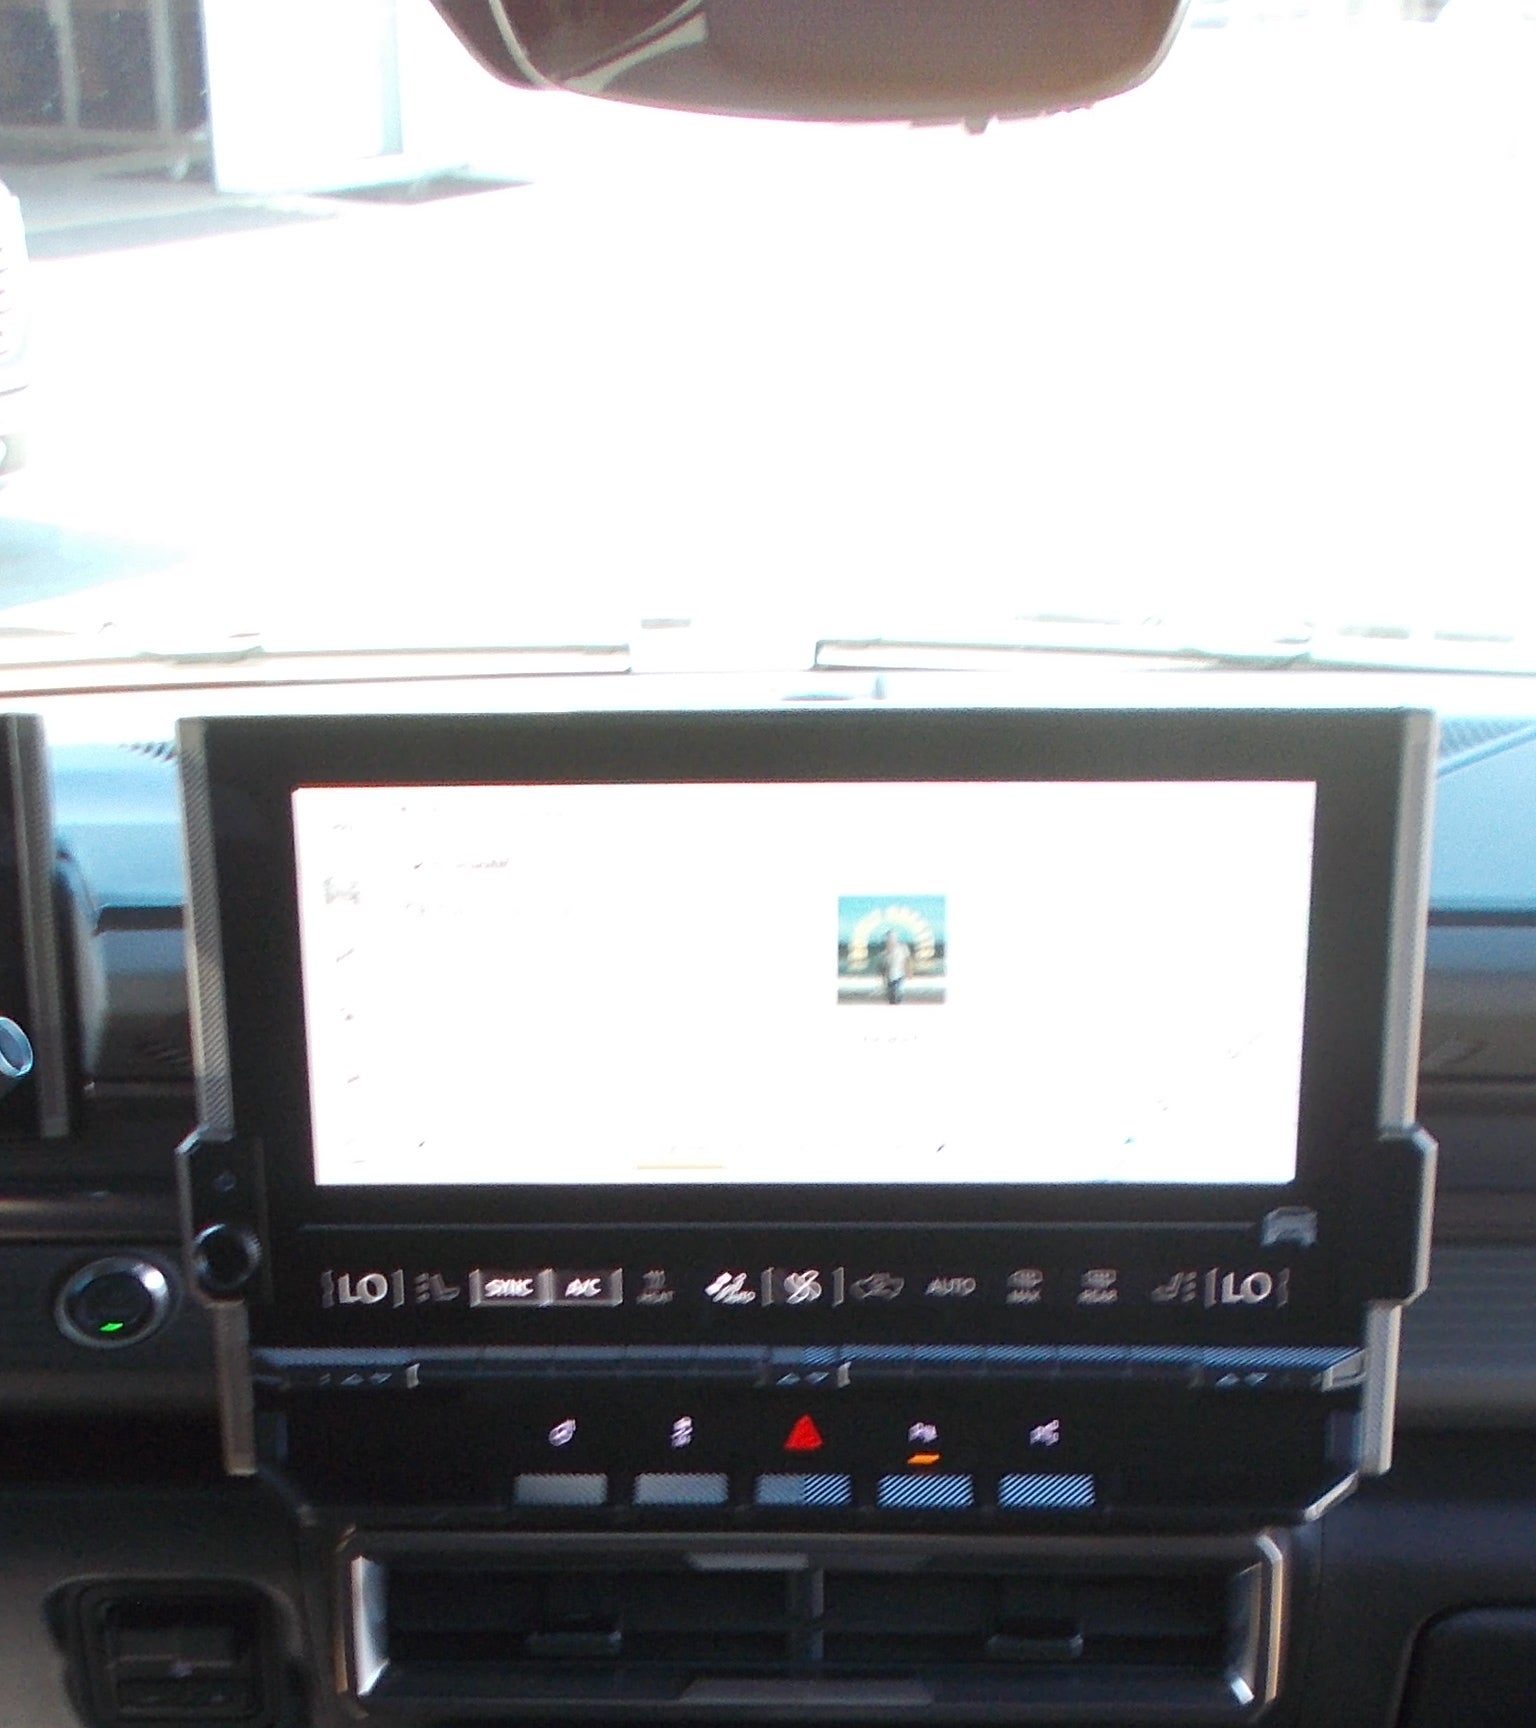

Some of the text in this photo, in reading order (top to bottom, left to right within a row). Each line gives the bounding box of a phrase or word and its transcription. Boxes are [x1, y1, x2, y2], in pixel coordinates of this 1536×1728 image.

[338, 1273, 389, 1304] LO
[484, 1278, 534, 1297] SYNC
[925, 1277, 976, 1296] AUTO
[1222, 1272, 1272, 1303] LO
